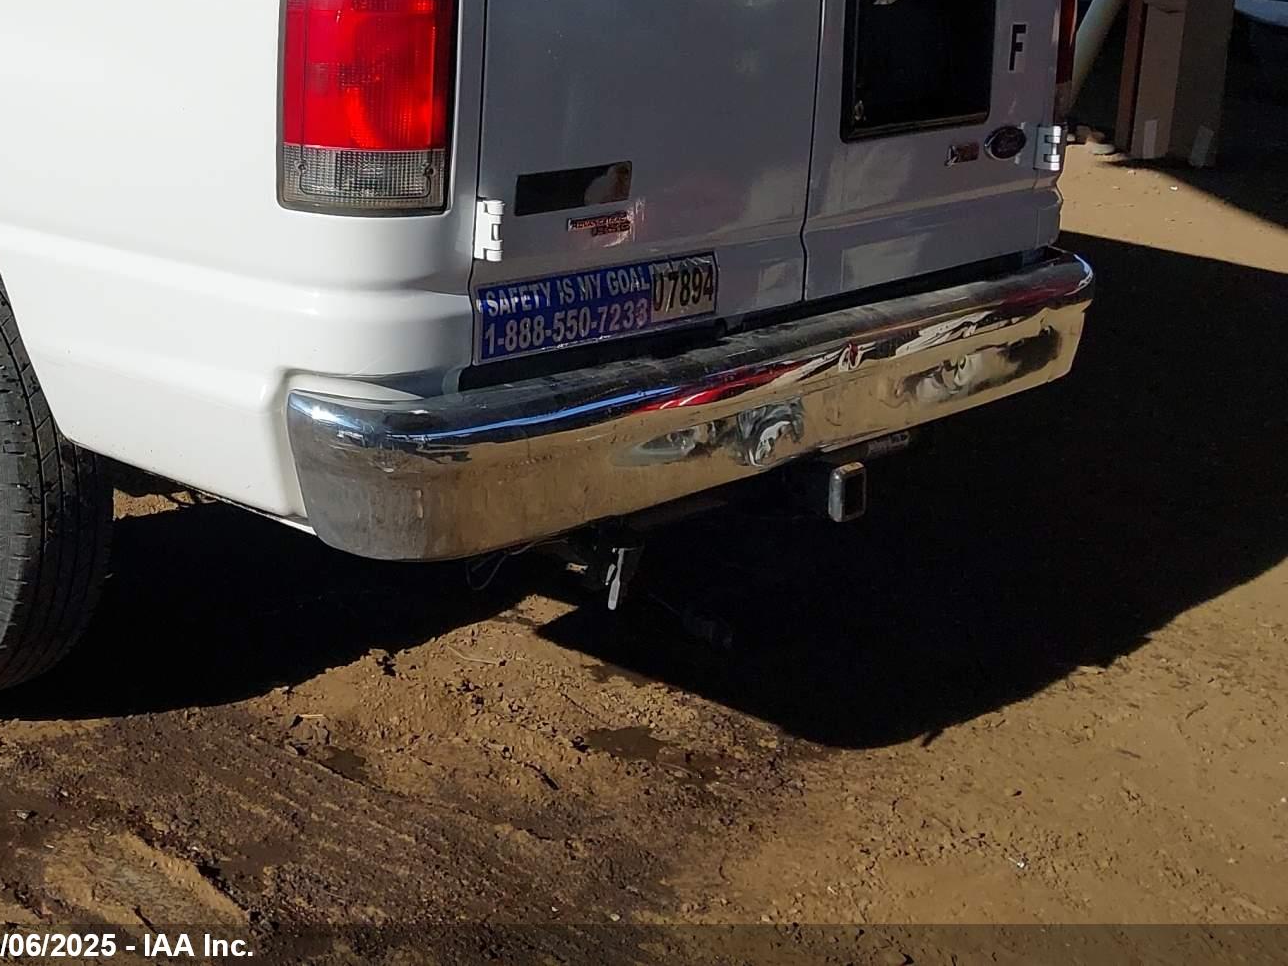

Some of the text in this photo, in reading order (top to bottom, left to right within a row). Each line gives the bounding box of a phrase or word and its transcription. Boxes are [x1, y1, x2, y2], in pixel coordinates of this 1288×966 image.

[1009, 24, 1027, 71] F
[486, 281, 552, 317] SAFETY
[559, 277, 576, 305] IS
[583, 271, 602, 301] MY
[607, 265, 651, 297] GOAL
[485, 297, 648, 355] 1-888-550-7233
